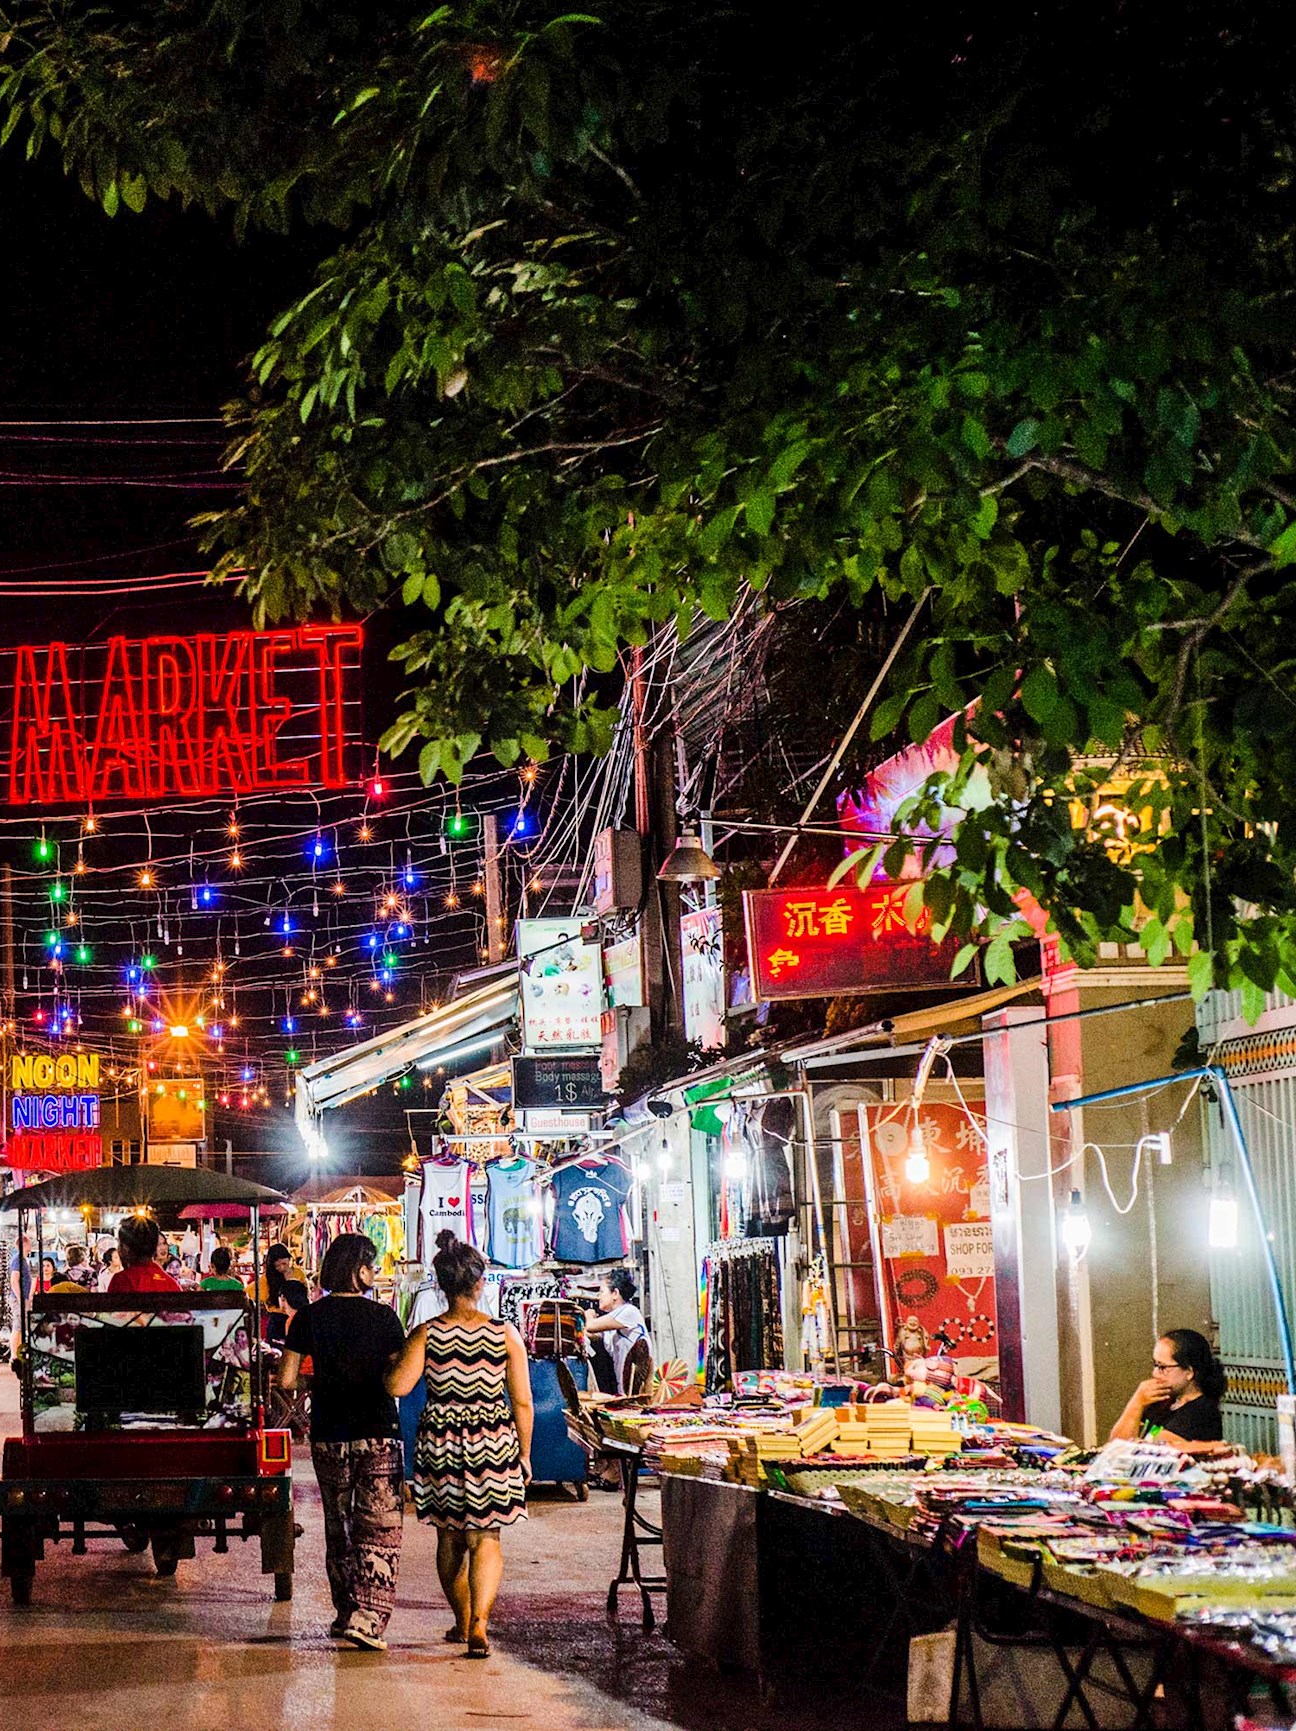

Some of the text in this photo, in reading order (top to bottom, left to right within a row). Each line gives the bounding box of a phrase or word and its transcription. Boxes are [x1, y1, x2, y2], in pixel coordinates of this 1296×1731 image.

[9, 624, 364, 804] MARKET
[783, 897, 853, 938] 沉香
[12, 1053, 100, 1089] NOON
[535, 1071, 560, 1084] Body
[554, 1082, 578, 1103] 1$
[12, 1095, 98, 1128] NIGHT
[530, 1117, 585, 1128] Guesthouse
[11, 1135, 102, 1169] MARKET
[438, 1197, 444, 1208] I
[950, 1243, 974, 1255] SHOP
[976, 1242, 993, 1254] FOR
[951, 1266, 973, 1275] 093
